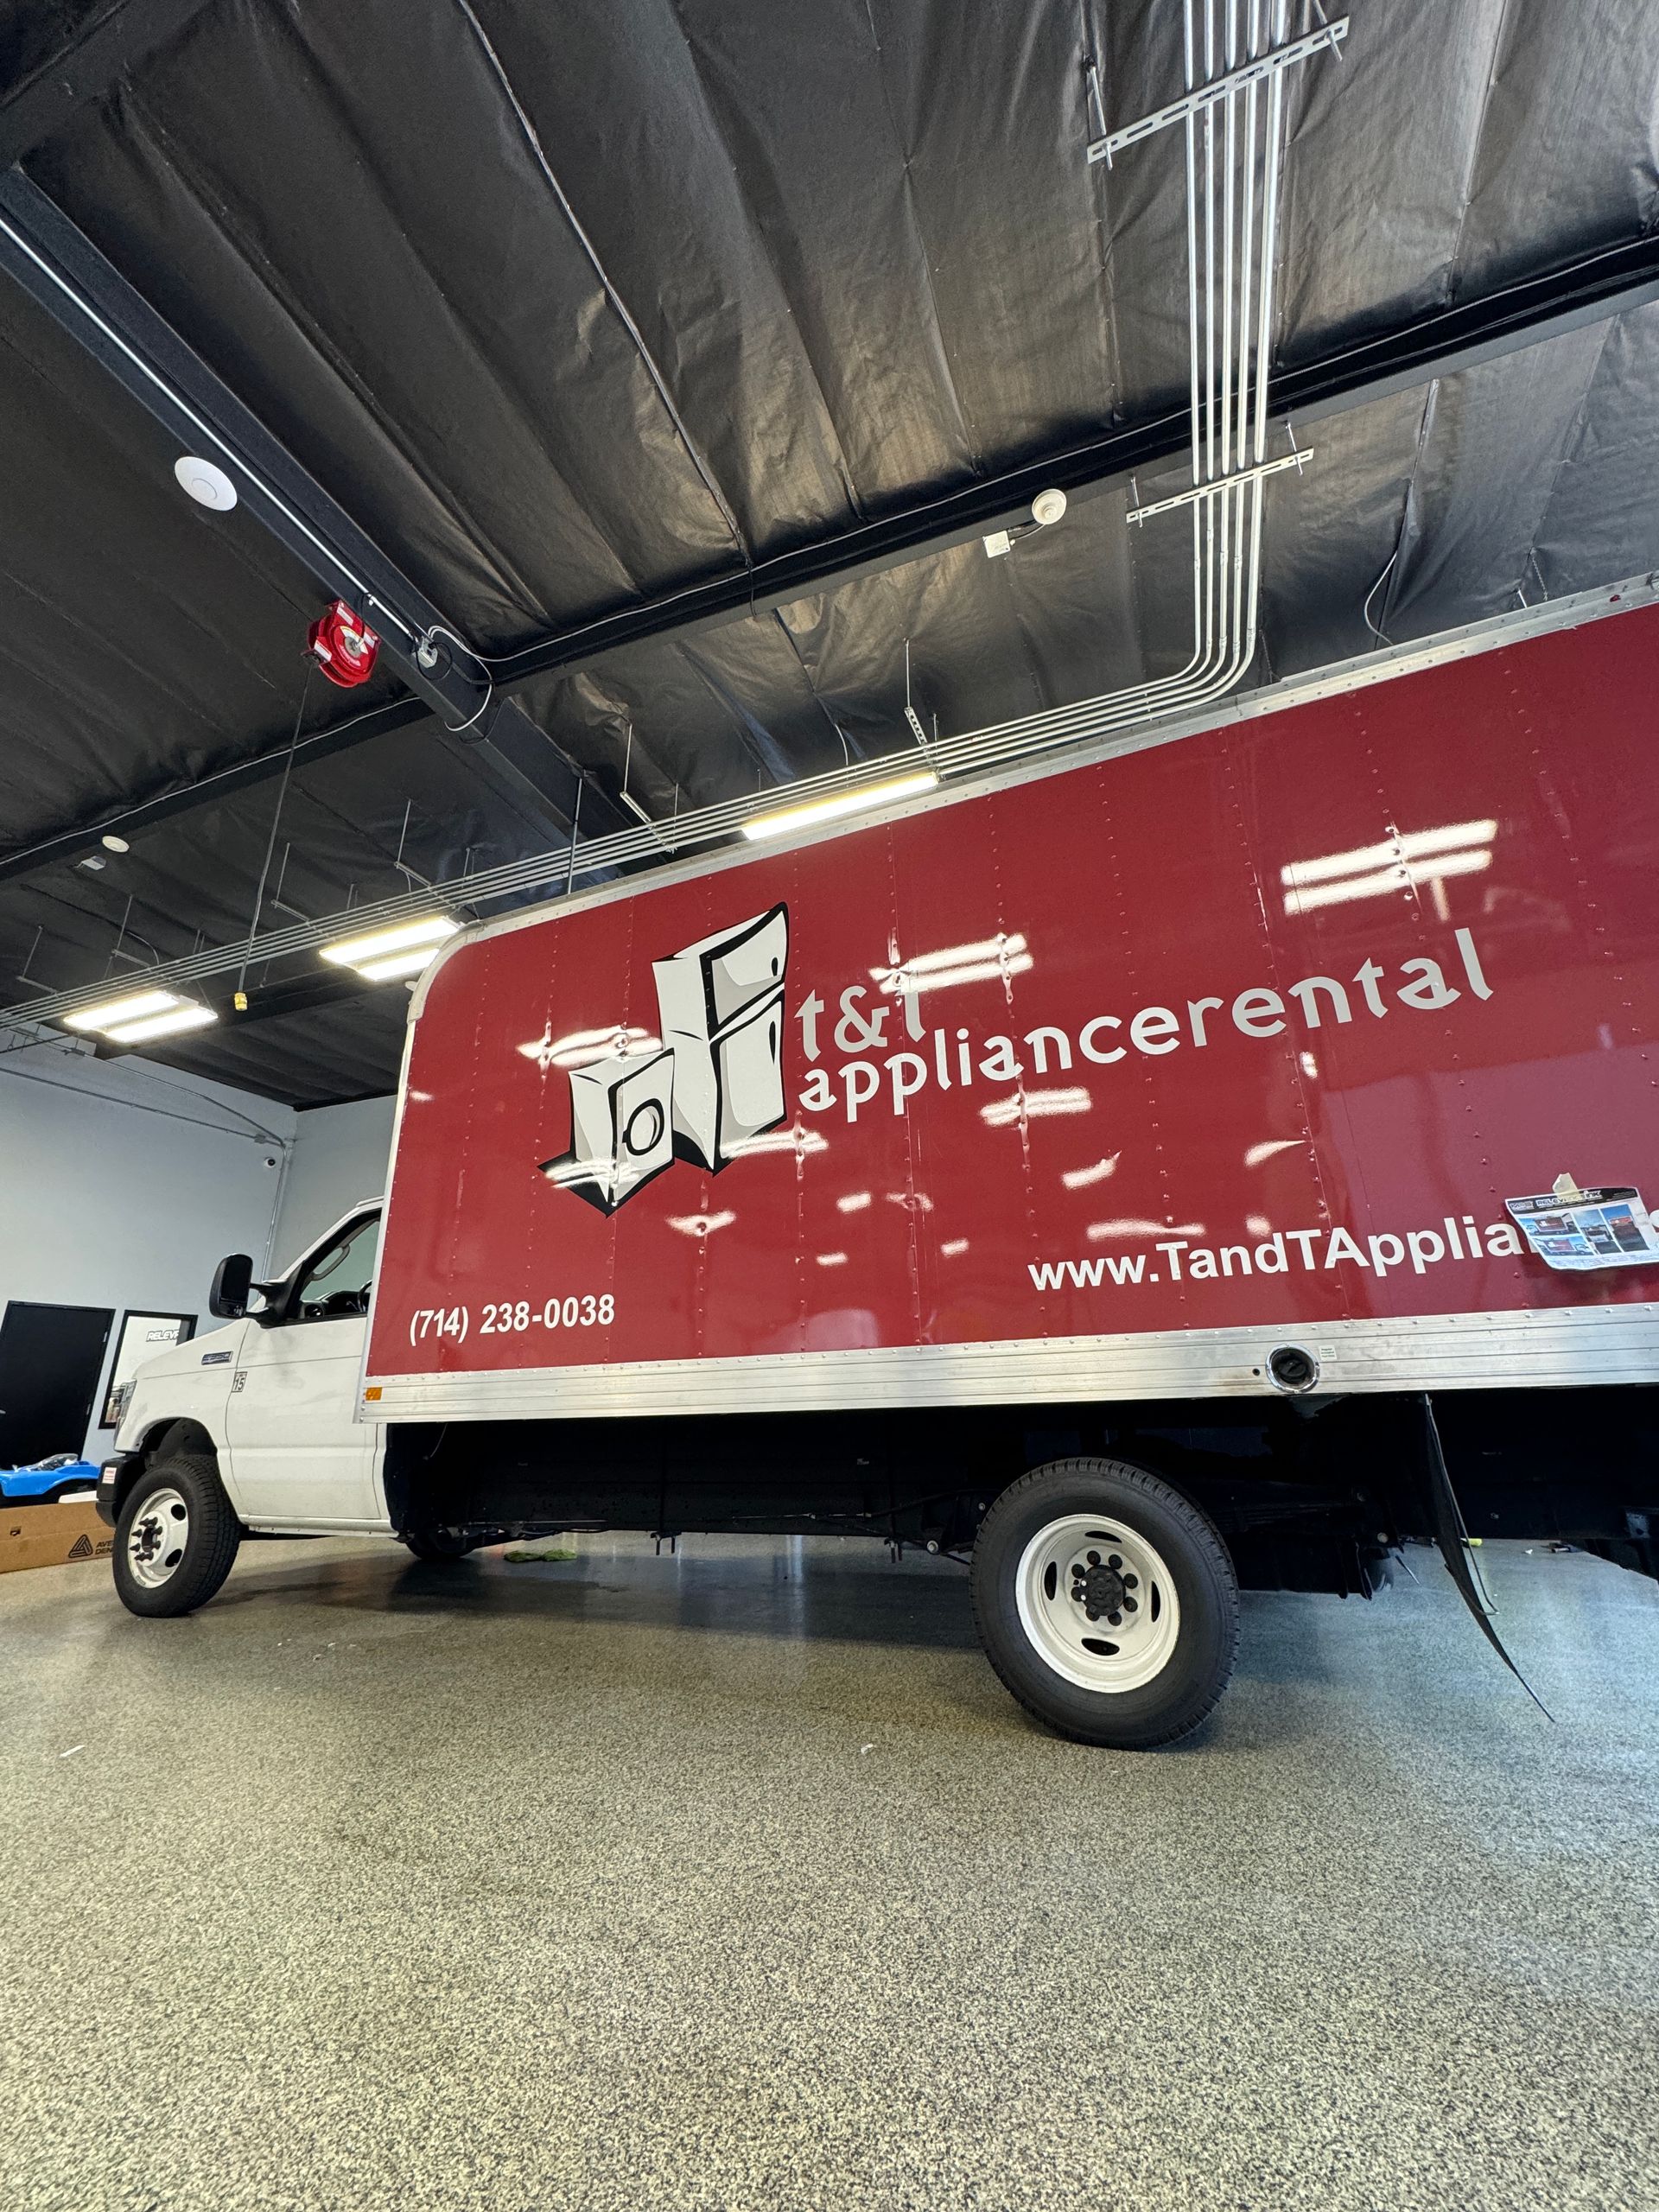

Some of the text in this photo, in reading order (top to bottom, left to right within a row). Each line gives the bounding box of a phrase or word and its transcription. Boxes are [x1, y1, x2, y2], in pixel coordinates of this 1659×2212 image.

[798, 928, 1494, 1122] appliancerental
[1027, 1217, 1539, 1292] www.TandTApplia
[410, 1294, 615, 1346] (714) 238-0038
[235, 1376, 245, 1391] 15
